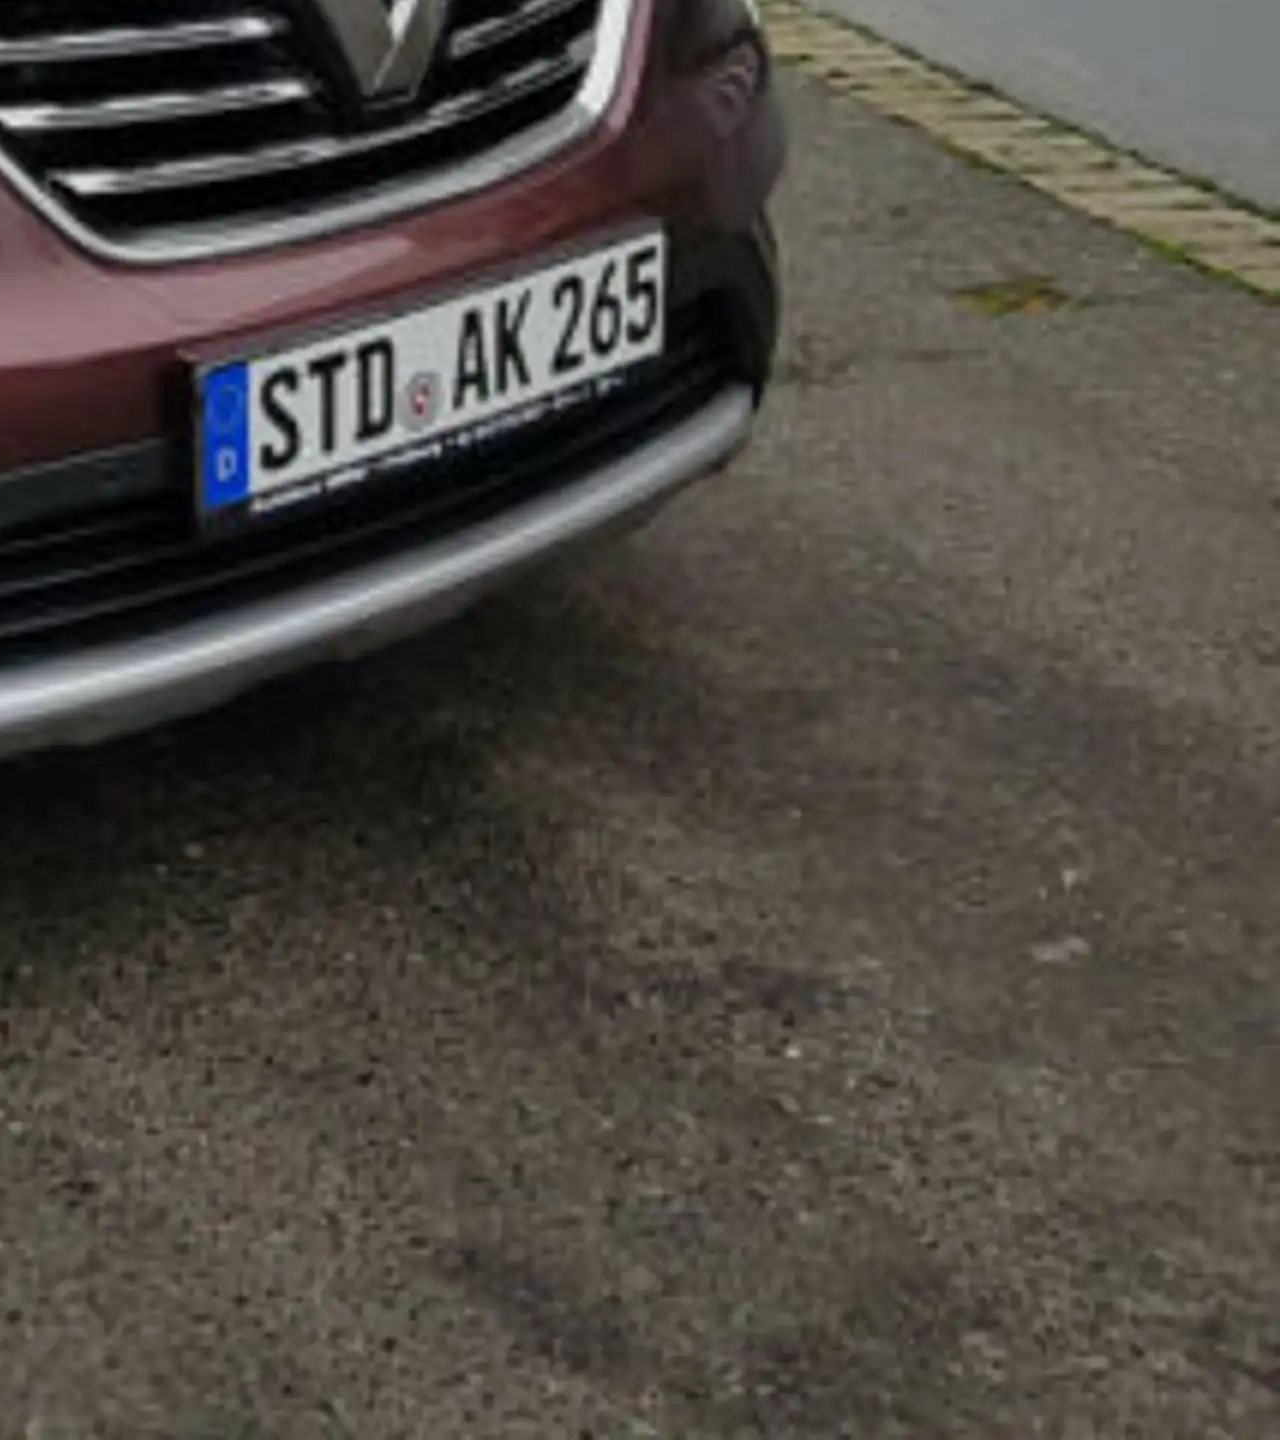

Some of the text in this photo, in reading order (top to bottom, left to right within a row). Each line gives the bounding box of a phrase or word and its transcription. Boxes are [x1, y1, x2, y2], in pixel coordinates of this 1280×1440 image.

[259, 337, 394, 469] STD
[452, 289, 532, 409] AK
[552, 247, 657, 374] 265
